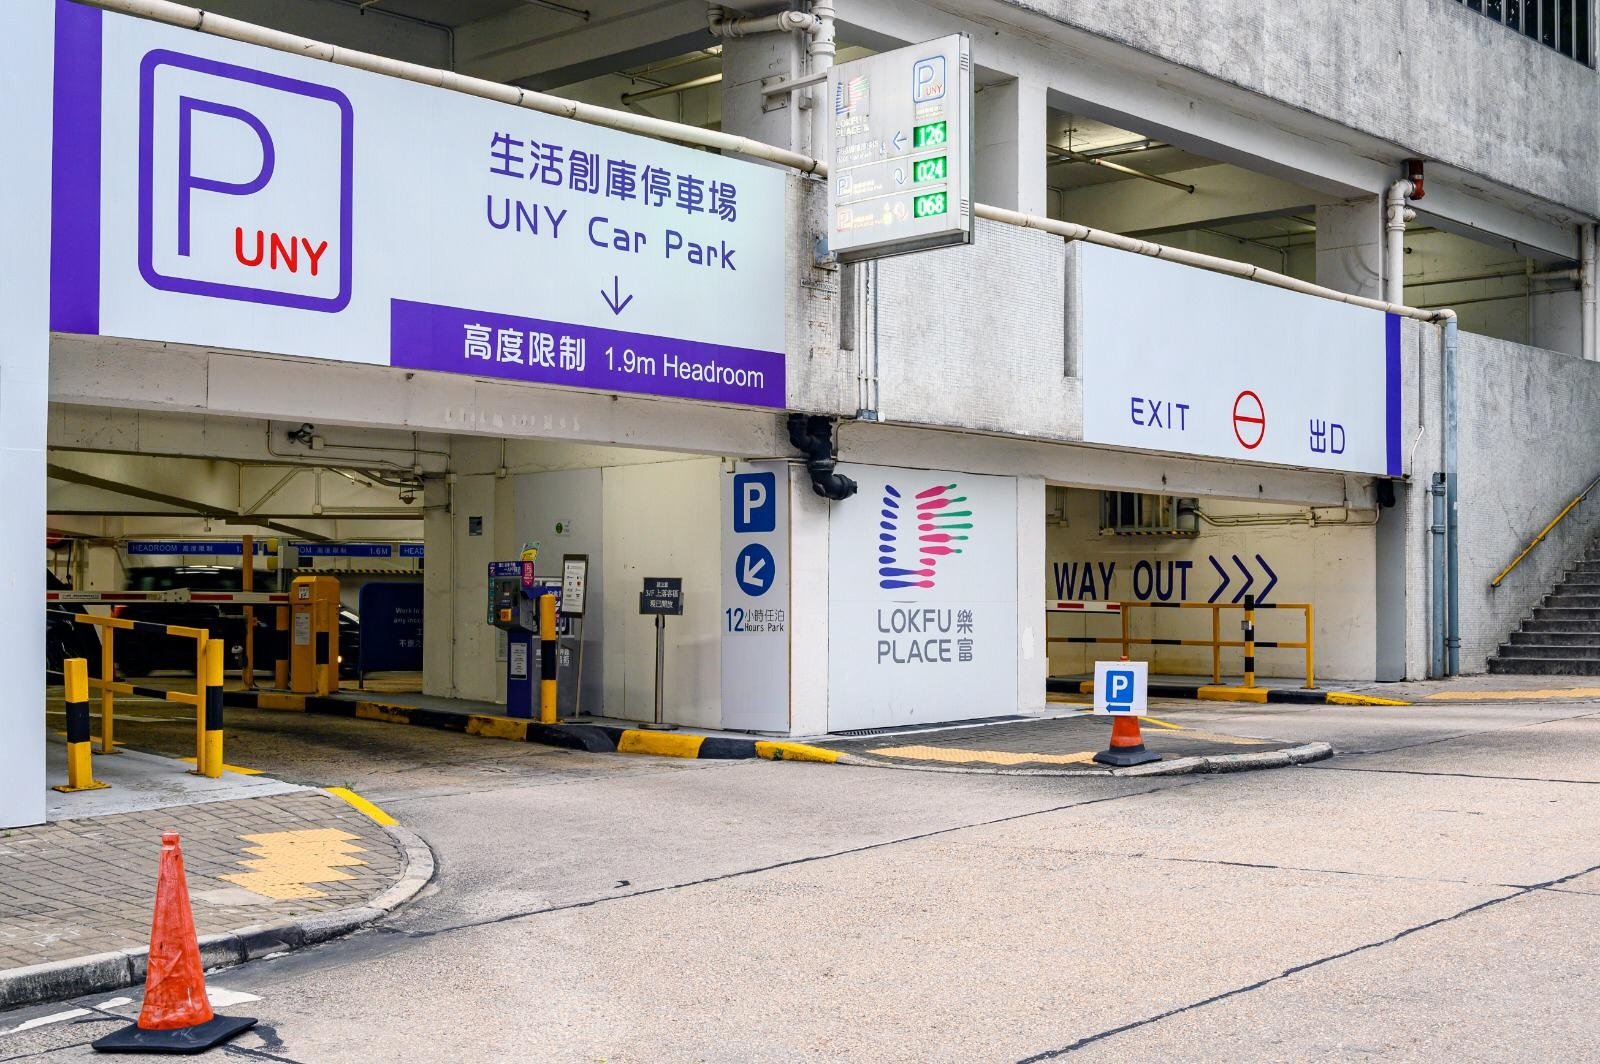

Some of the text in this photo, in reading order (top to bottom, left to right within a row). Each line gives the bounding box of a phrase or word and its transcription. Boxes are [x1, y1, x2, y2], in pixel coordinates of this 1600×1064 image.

[919, 125, 943, 147] 126
[178, 95, 275, 257] P
[489, 132, 737, 223] 生活創庫停車場
[918, 160, 943, 182] 024
[918, 196, 943, 217] 068
[486, 194, 737, 271] UNY Car Park
[234, 227, 328, 276] UNY
[463, 323, 764, 390] 高度限制 1.9m Headroom
[1131, 397, 1190, 431] EXIT
[743, 482, 766, 524] P
[132, 544, 178, 553] HEADROOM
[403, 548, 424, 556] HEAD
[1053, 560, 1193, 601] WAY OUT
[726, 607, 744, 632] 12
[744, 608, 785, 622] 小時任泊
[744, 622, 784, 632] Hours Park
[877, 608, 952, 634] LOKFU
[877, 639, 952, 665] PLACE
[1112, 675, 1129, 698] P
